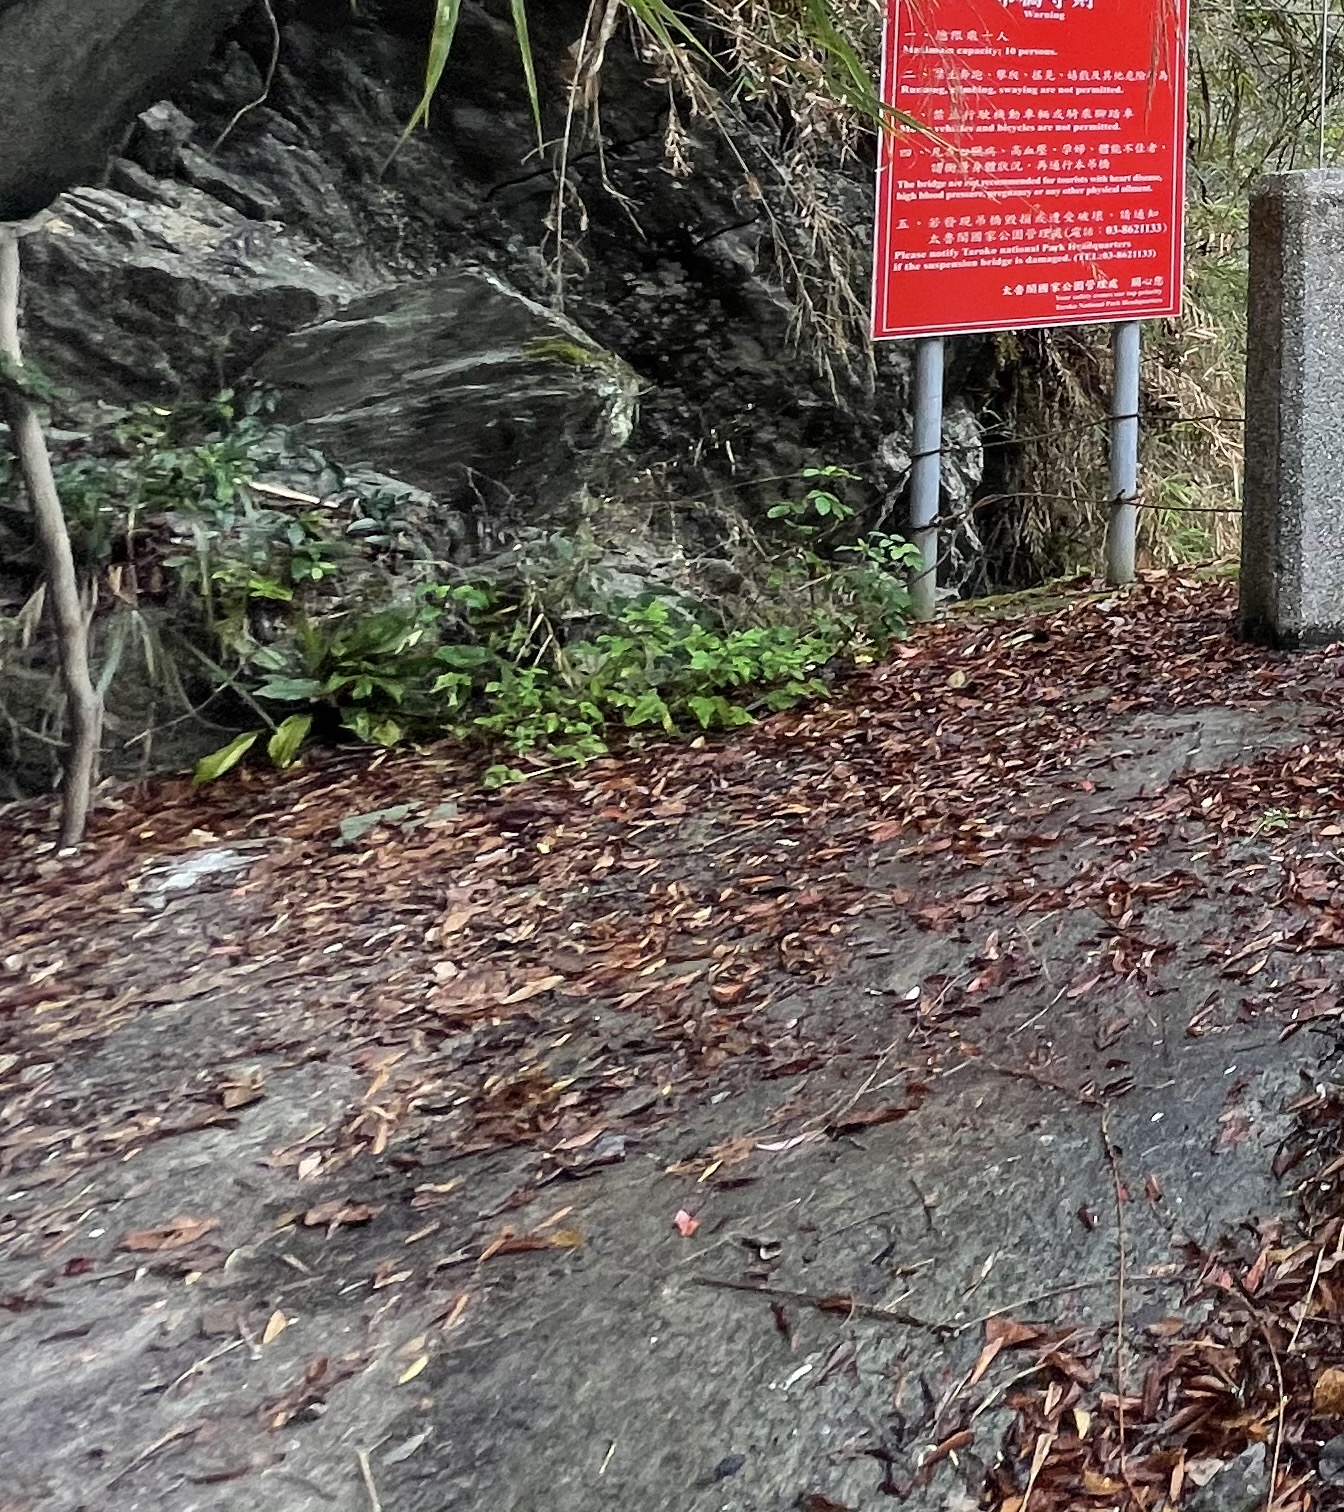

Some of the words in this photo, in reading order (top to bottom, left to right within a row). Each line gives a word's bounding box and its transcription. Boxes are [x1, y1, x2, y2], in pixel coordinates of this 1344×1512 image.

[1023, 10, 1066, 20] Warning
[1005, 46, 1017, 55] 10
[1018, 47, 1058, 57] persons.
[999, 86, 1038, 95] swaying
[1058, 86, 1073, 94] not
[1075, 85, 1124, 96] permitted.
[975, 123, 995, 132] and
[997, 122, 1035, 134] bicycles
[1037, 123, 1054, 132] are
[1055, 123, 1071, 131] not
[1072, 122, 1122, 133] permitted.
[897, 179, 915, 189] The
[916, 179, 947, 190] bridge
[948, 180, 963, 188] are
[1042, 176, 1056, 184] for
[1090, 174, 1108, 183] with
[1109, 174, 1131, 183] heart
[896, 191, 917, 202] high
[918, 190, 945, 200] blood
[1045, 189, 1060, 198] any
[1061, 187, 1085, 196] other
[1086, 186, 1120, 196] physical
[894, 251, 927, 260] Please
[928, 248, 959, 259] notify
[961, 247, 998, 257] Taroko
[999, 244, 1040, 255] national
[1042, 243, 1066, 253] Park
[1067, 241, 1132, 252] Headquarters
[904, 262, 922, 271] the
[923, 259, 979, 271] suspension
[980, 256, 1013, 268] bridge
[1014, 256, 1024, 264] is
[1025, 254, 1072, 265] damaged.
